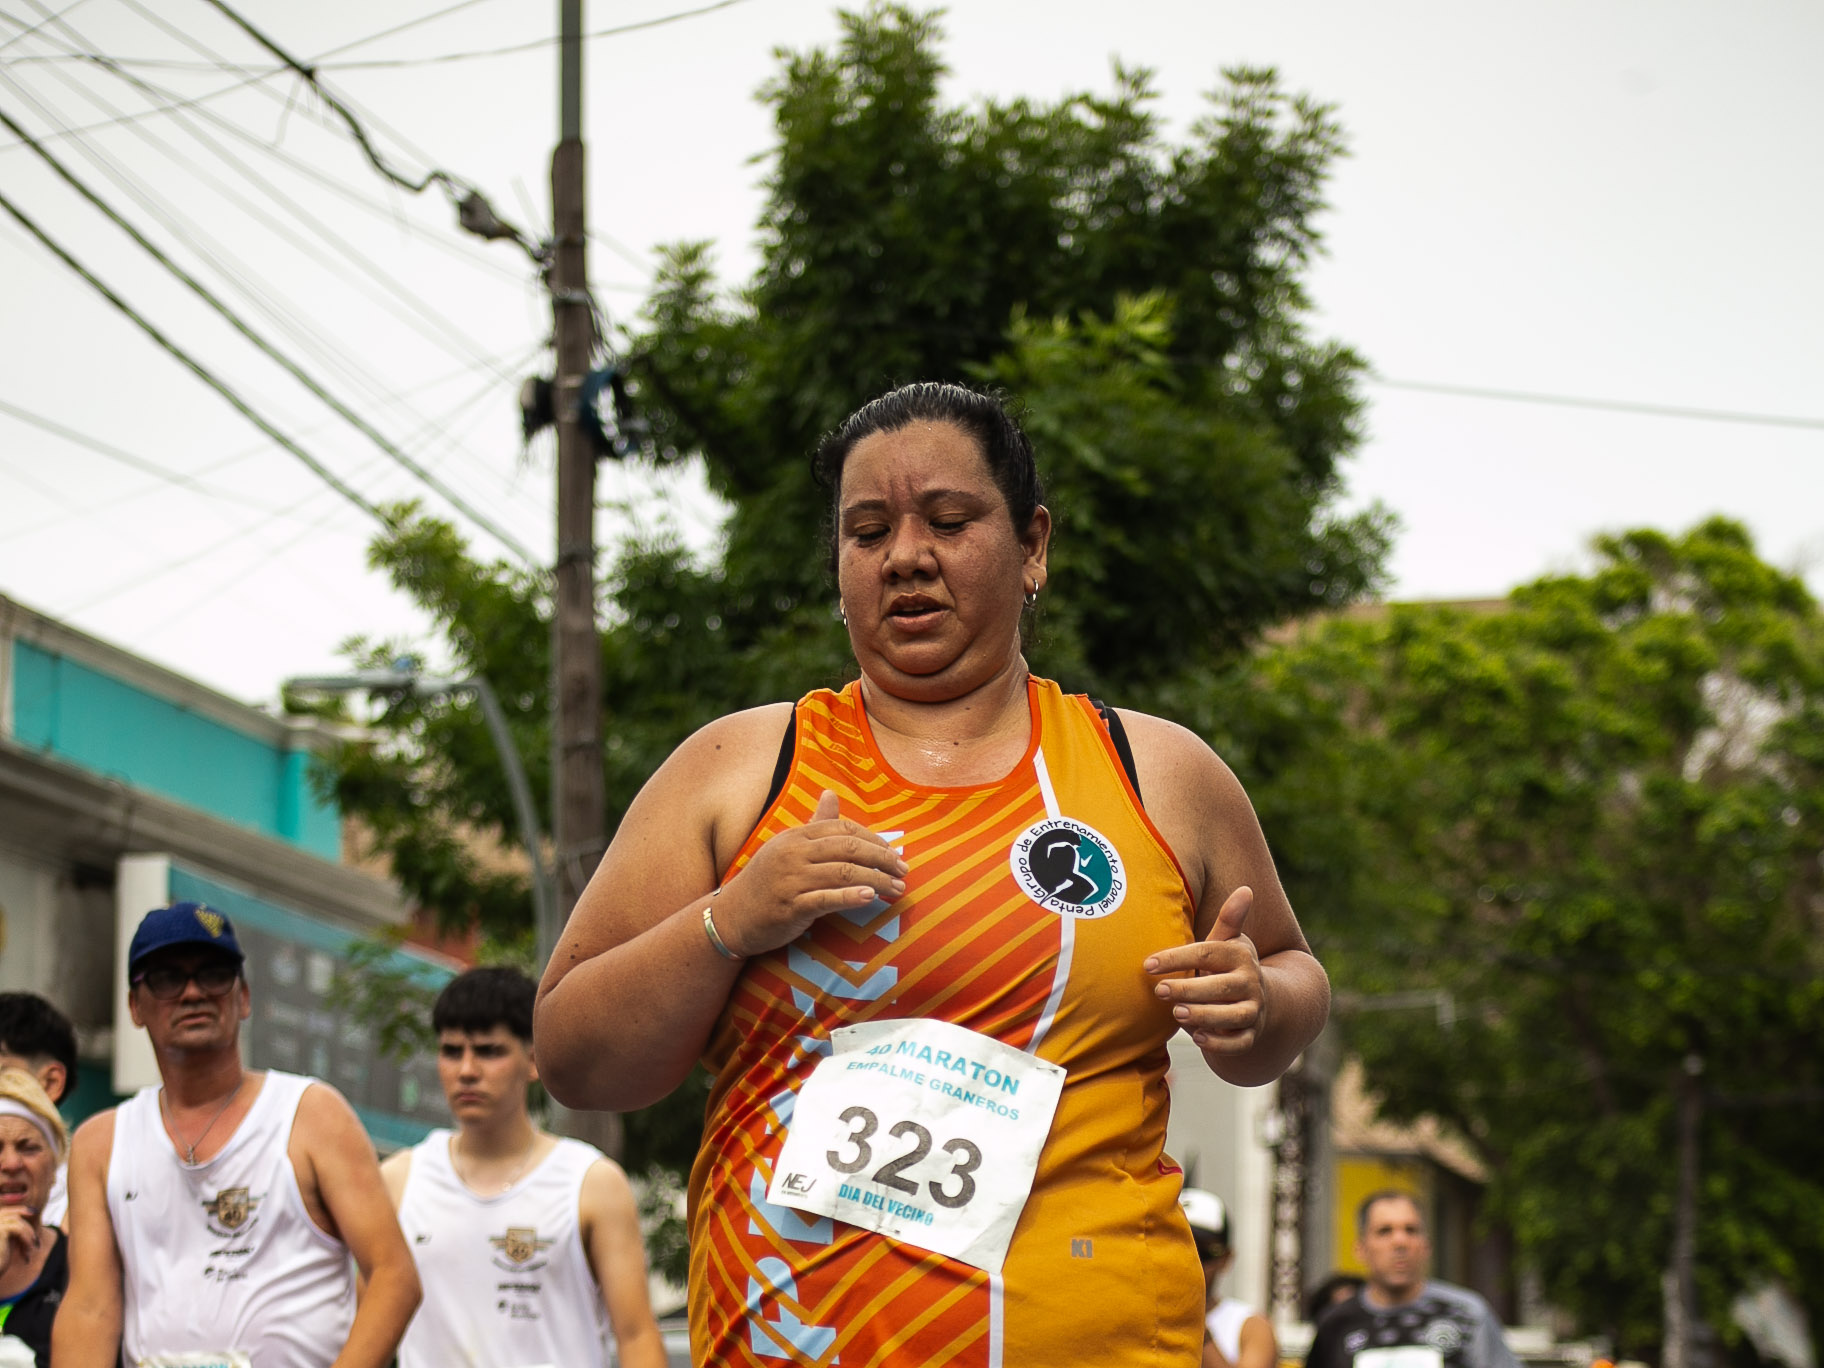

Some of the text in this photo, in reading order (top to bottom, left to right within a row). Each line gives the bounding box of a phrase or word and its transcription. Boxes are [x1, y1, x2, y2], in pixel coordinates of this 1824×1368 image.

[1017, 820, 1122, 916] Grupo de Entrenamiento Daniel Penta
[846, 1061, 1020, 1120] EMPALME GRANEROS
[896, 1041, 1020, 1095] MARATON
[782, 1173, 817, 1192] NEJ
[826, 1106, 983, 1209] 323
[838, 1184, 934, 1226] DIA DEL VECINO
